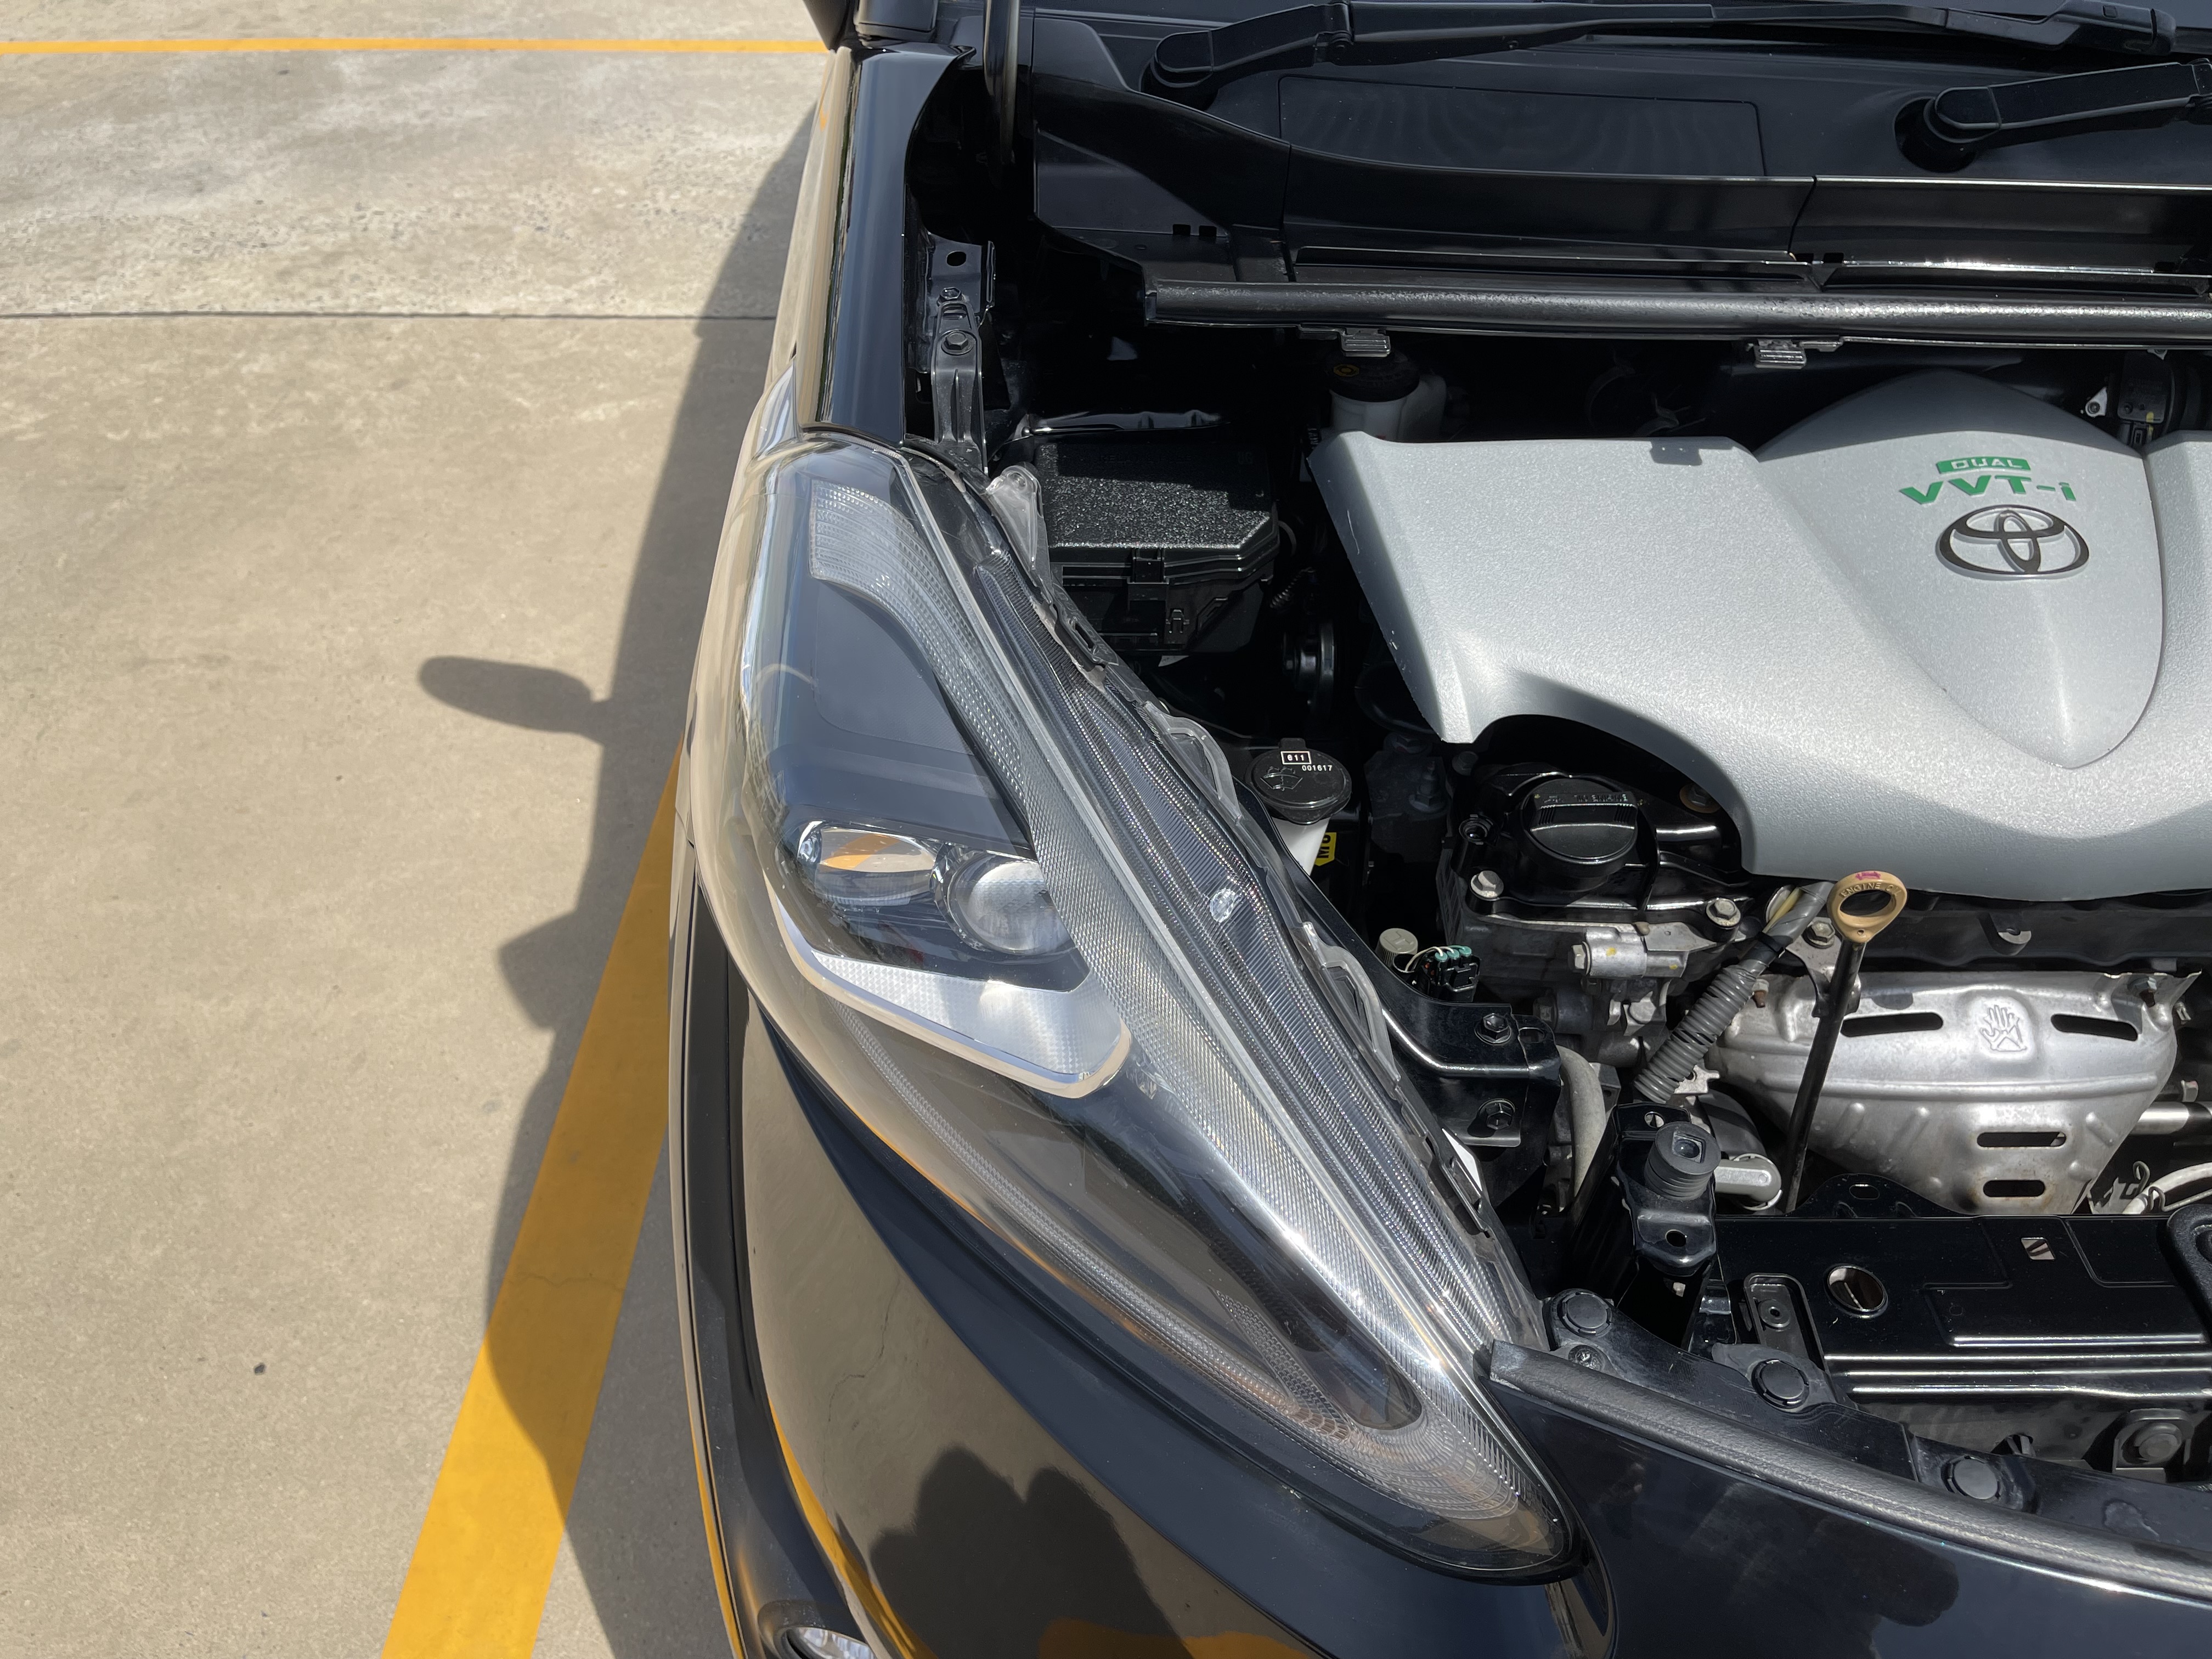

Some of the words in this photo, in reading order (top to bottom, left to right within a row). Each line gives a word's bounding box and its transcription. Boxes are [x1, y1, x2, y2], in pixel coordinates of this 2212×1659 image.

[1951, 458, 2023, 470] DUAL
[1899, 474, 2077, 505] VVT-i
[1840, 882, 1882, 897] ENGINE
[1886, 884, 1903, 896] OIL
